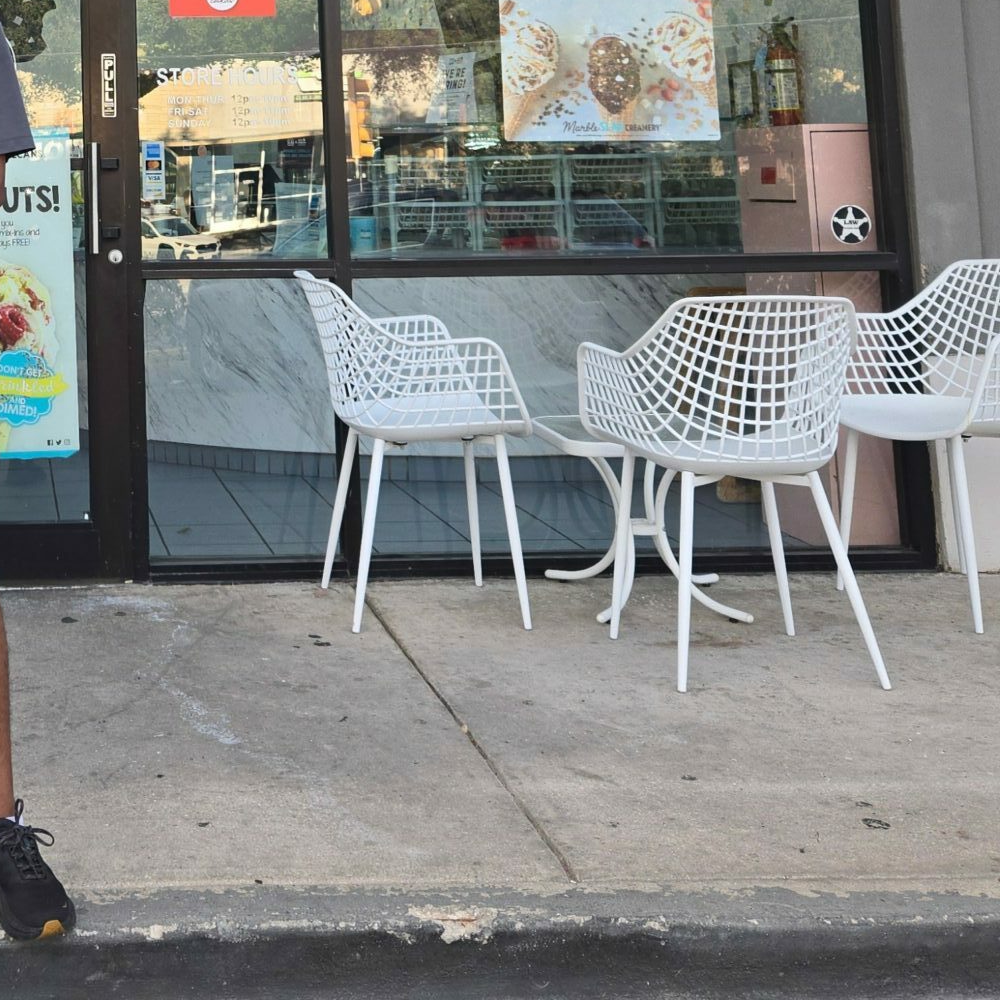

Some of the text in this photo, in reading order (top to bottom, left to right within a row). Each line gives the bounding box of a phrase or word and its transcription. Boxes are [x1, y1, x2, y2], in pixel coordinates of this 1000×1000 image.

[104, 60, 114, 102] PULL
[156, 65, 298, 87] STORE HOURS
[562, 121, 600, 132] Marble
[0, 185, 60, 213] UTS!
[26, 228, 40, 236] and
[12, 239, 31, 247] FREE!
[26, 368, 43, 377] GET
